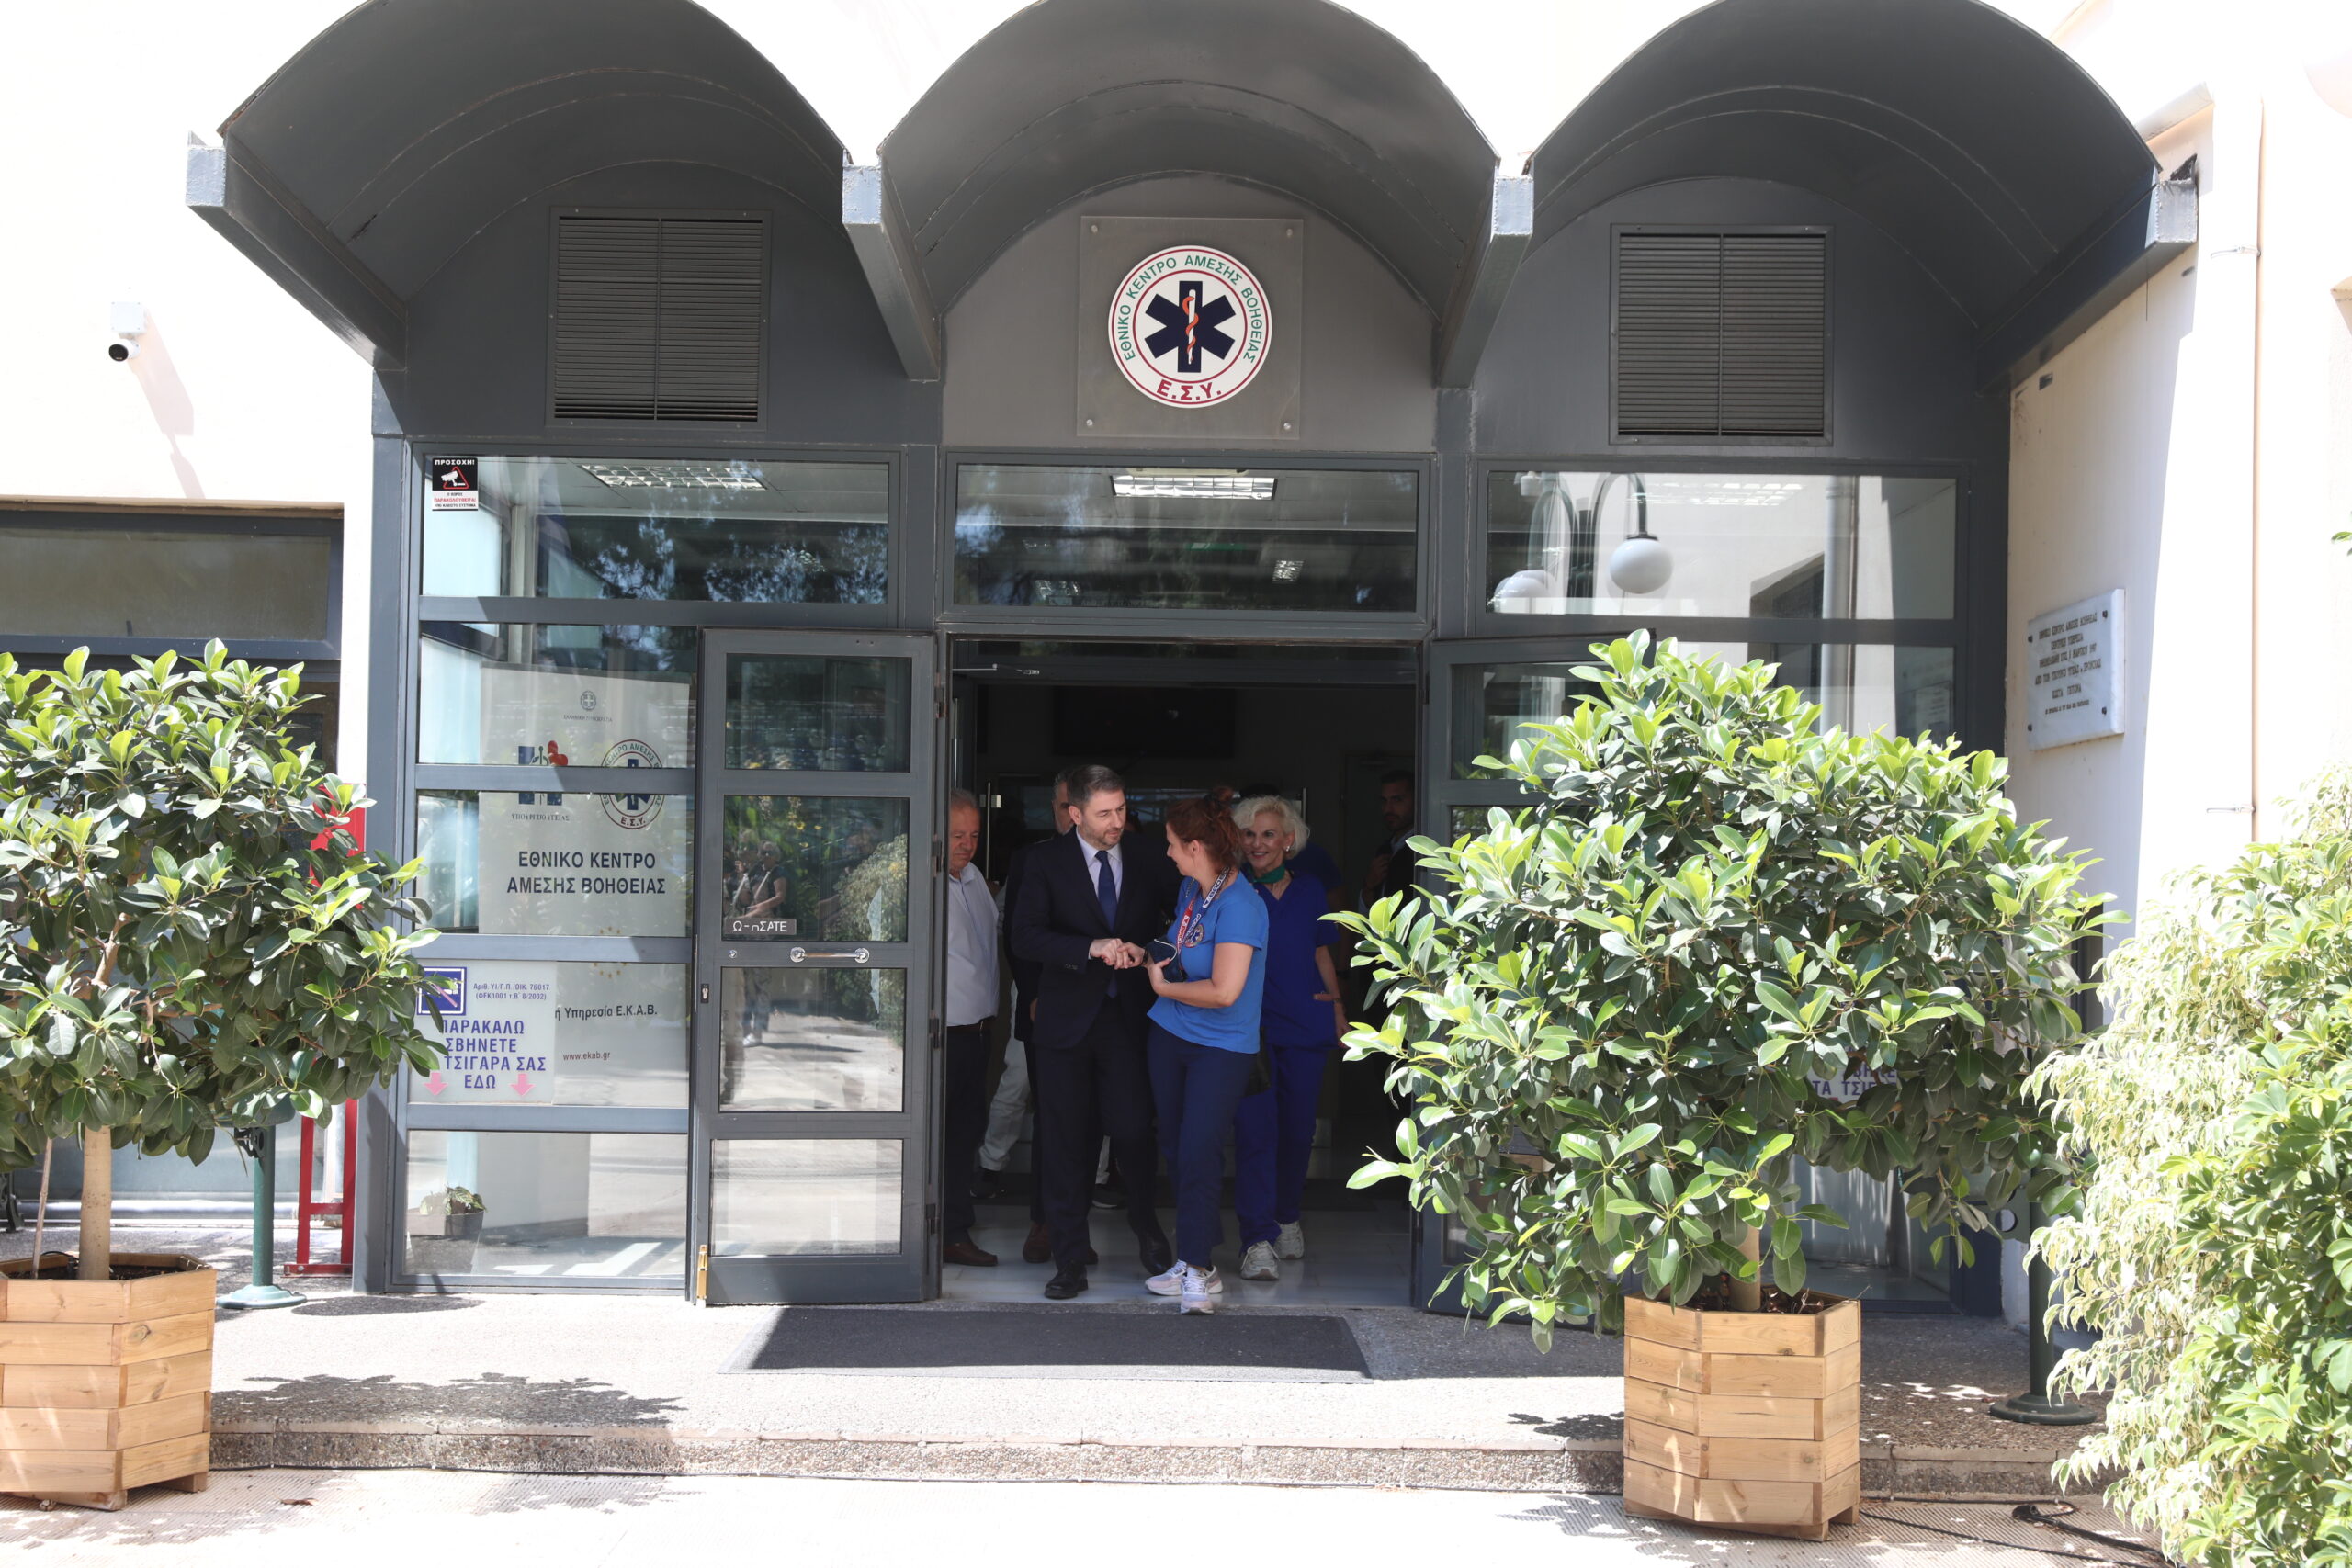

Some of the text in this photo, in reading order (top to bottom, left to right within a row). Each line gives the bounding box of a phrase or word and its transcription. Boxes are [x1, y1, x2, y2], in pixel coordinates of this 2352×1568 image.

[1117, 254, 1263, 364] ΕΘΝΙΚΟ ΚΕΝΤΡΟ ΑΜΕΣΗΣ ΒΟΗΘΕΙΑΣ
[1156, 378, 1222, 400] Ε.Σ.Υ.
[518, 851, 656, 869] ΕΘΝΙΚΟ ΚΕΝΤΡΟ
[506, 876, 666, 895] ΑΜΕΣΗΣ ΒΟΗΘΕΙΑΣ
[564, 1005, 613, 1021] Υπηρεσία
[616, 1004, 658, 1016] Ε.Κ.Α.Β.
[446, 1038, 517, 1053] ΣΒΗΝΕΤΕ
[444, 1056, 547, 1071] ΤΣΙΓΑΡΑ ΣΑΣ
[562, 1051, 611, 1061] www.ekab.gr
[464, 1074, 496, 1089] ΕΔΩ
